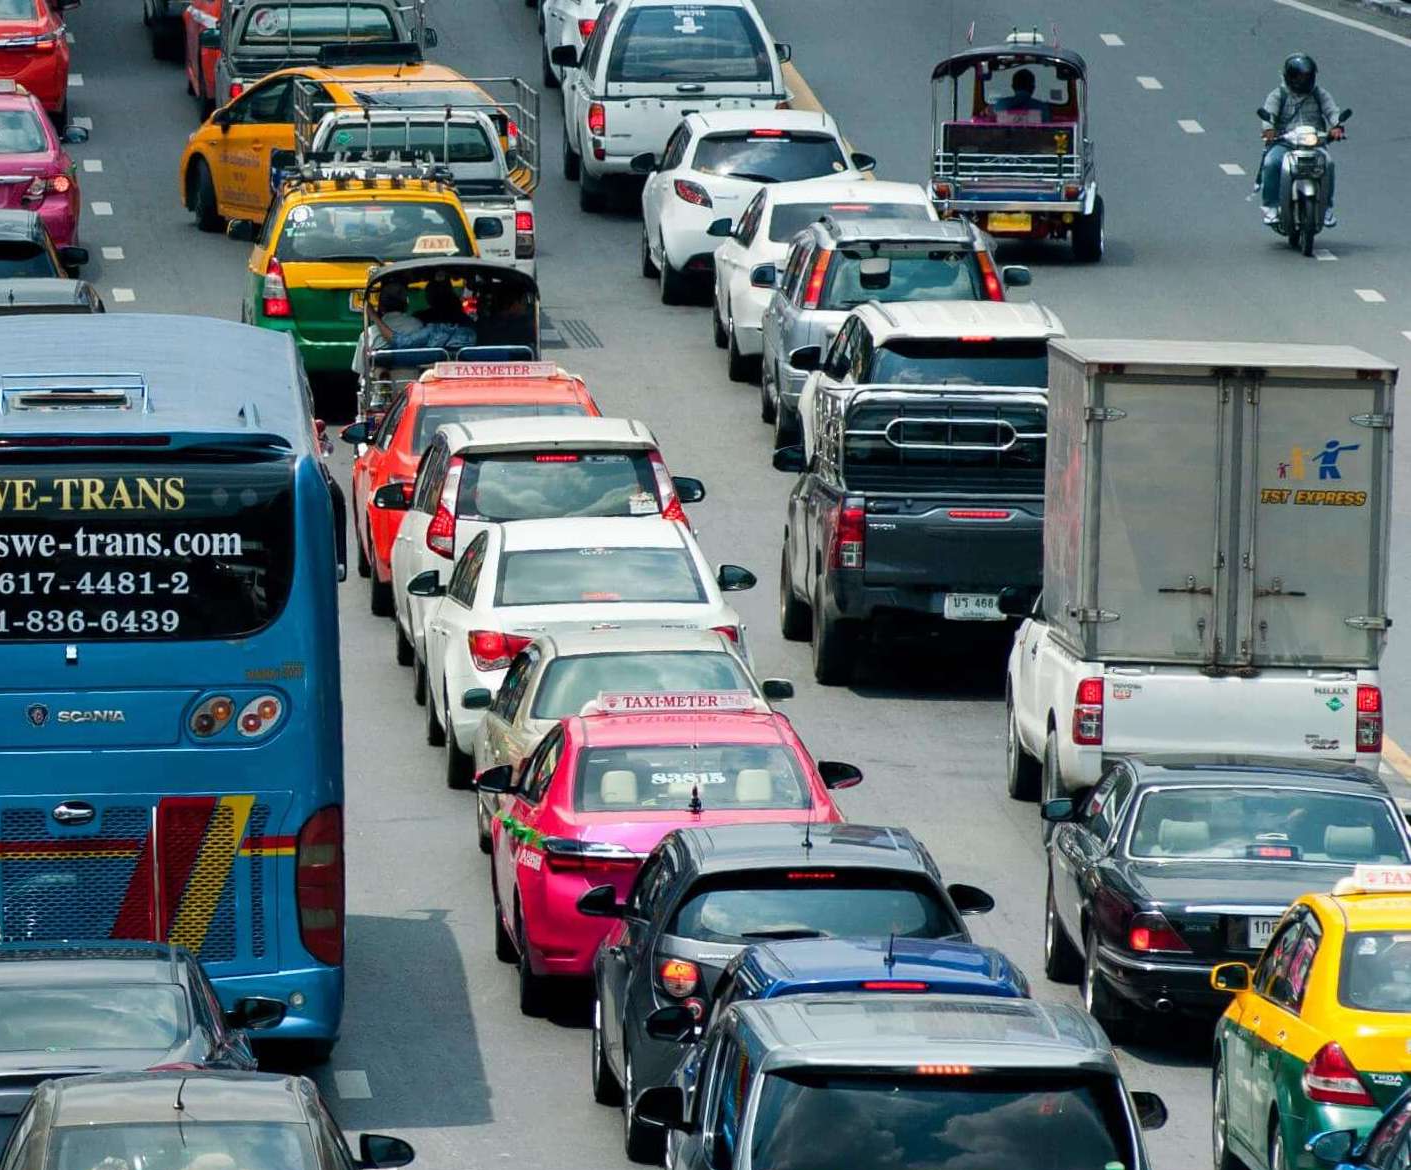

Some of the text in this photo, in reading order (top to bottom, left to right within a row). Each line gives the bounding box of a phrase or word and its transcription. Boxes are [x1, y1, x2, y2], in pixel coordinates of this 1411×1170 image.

[423, 236, 450, 250] TAXI
[1260, 488, 1368, 507] TST EXPRESS
[57, 710, 126, 722] SCANIA
